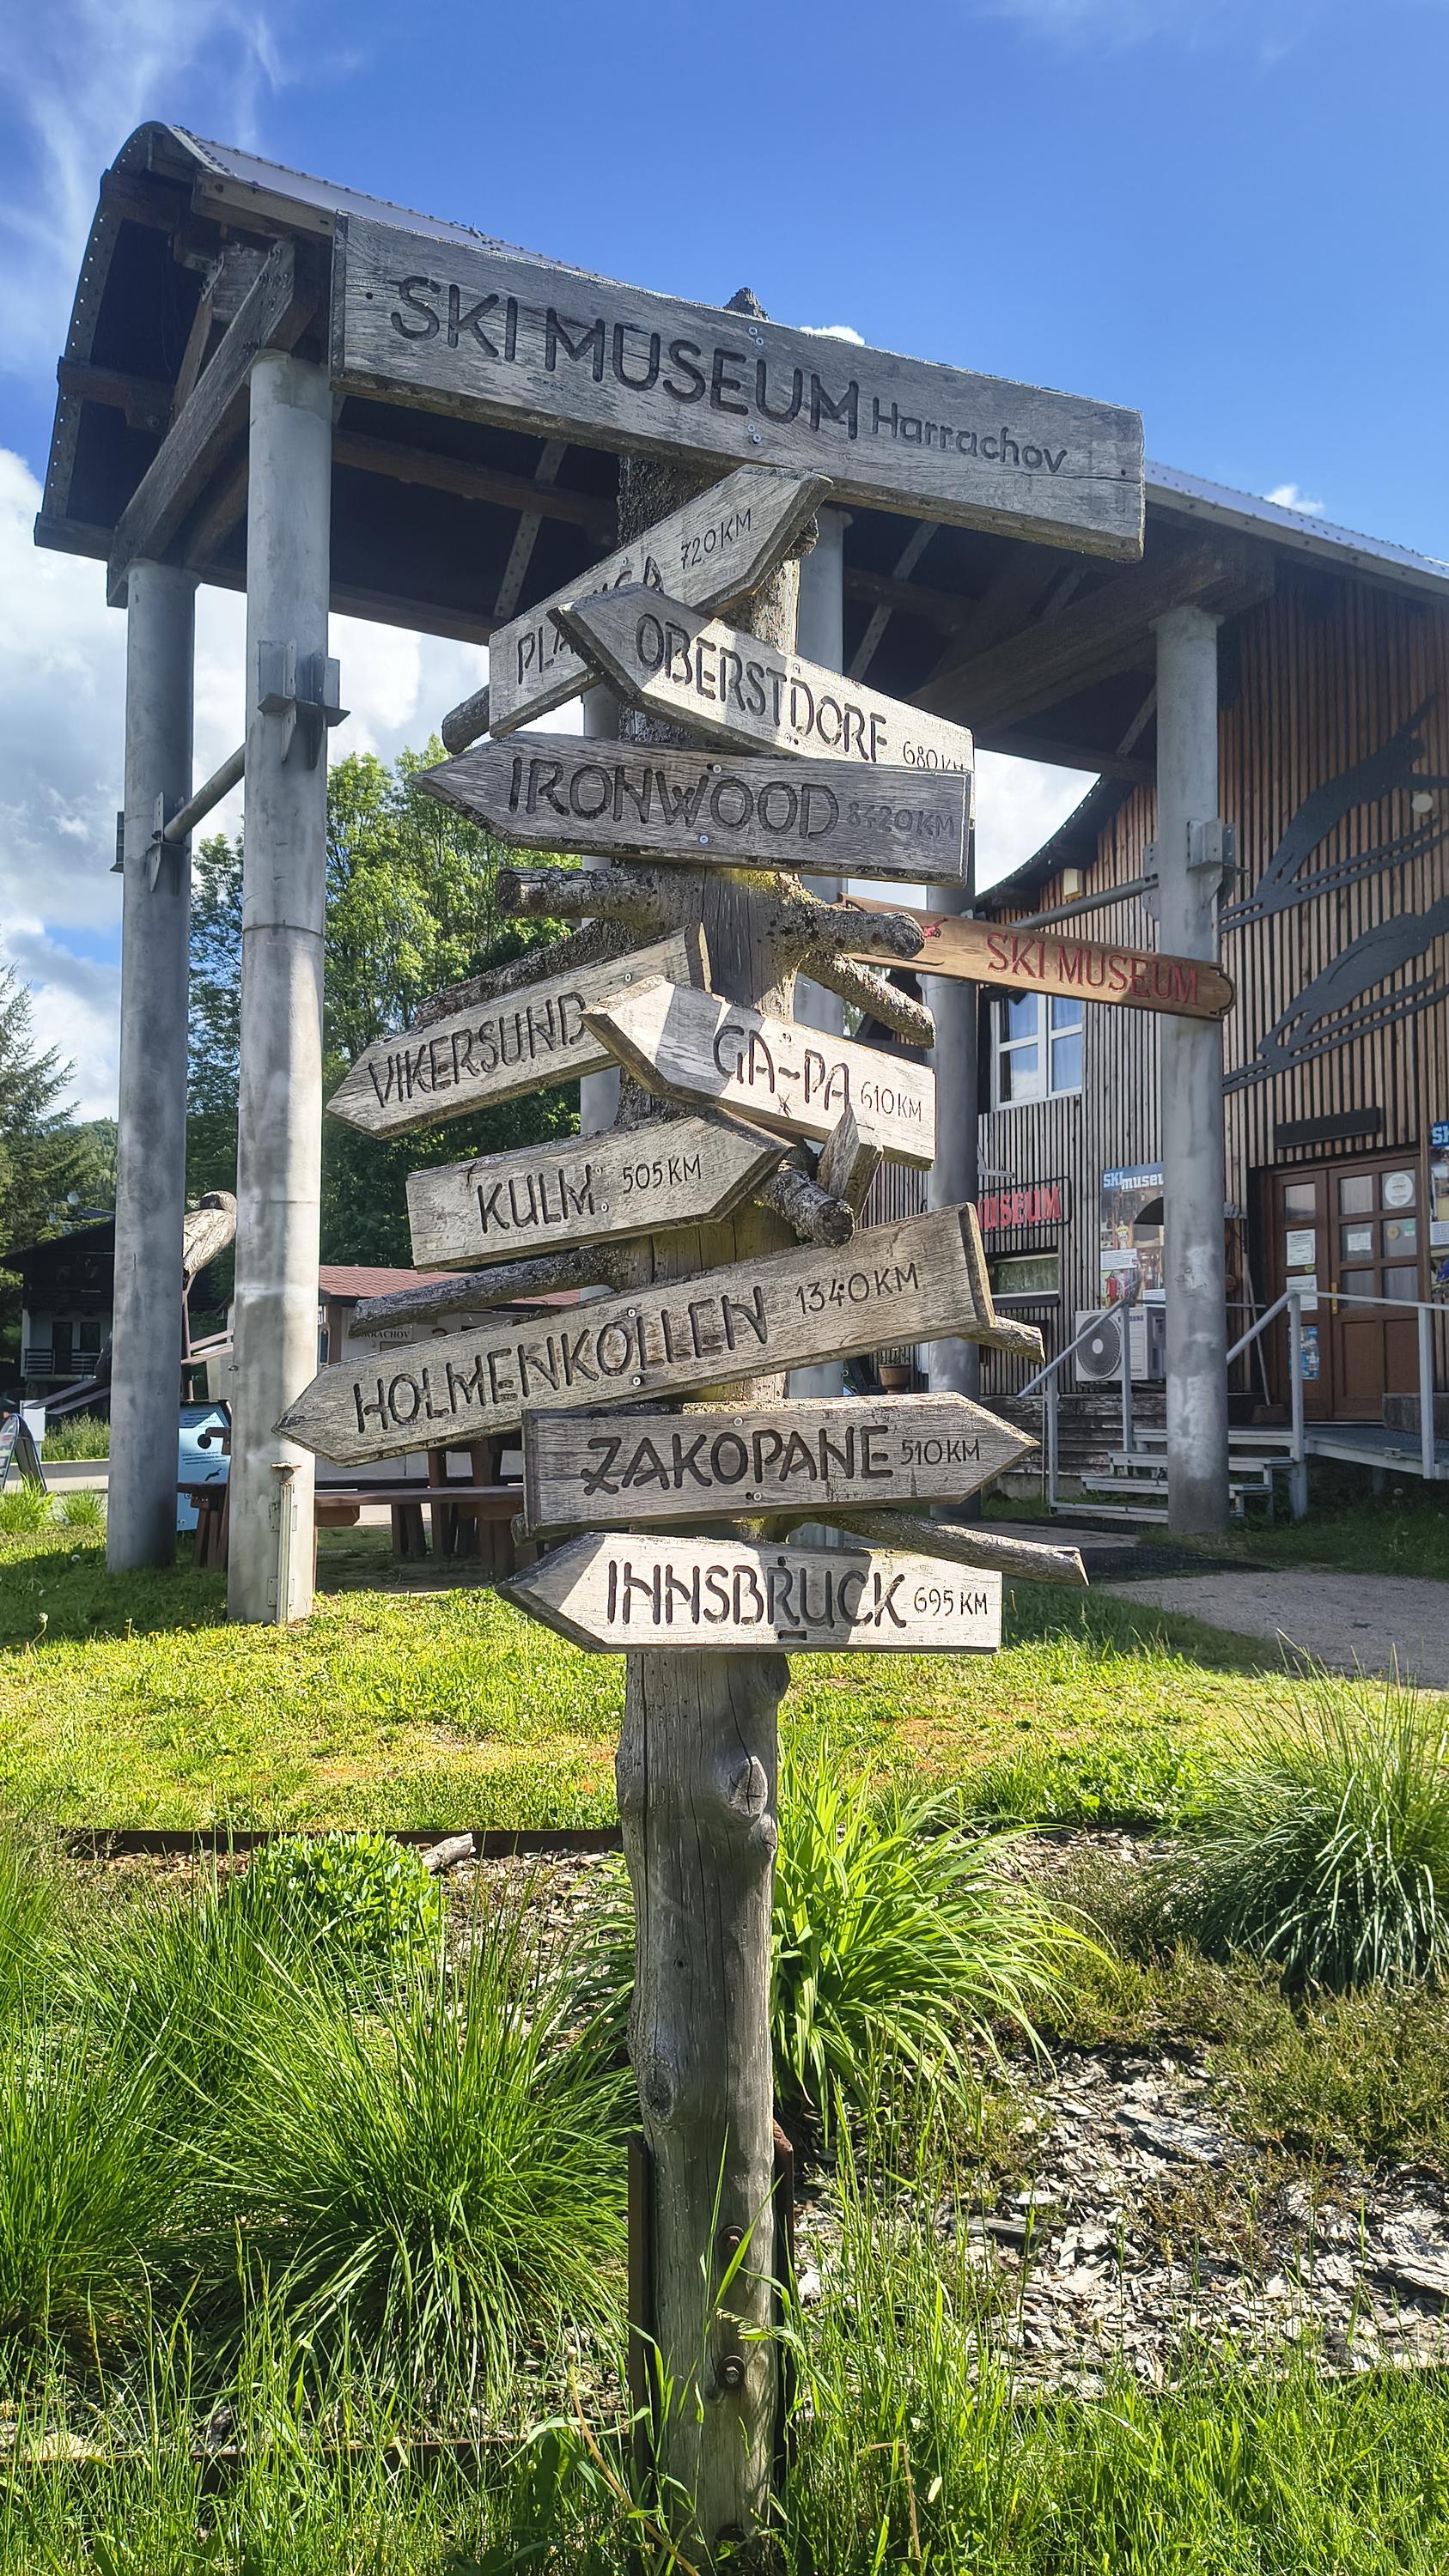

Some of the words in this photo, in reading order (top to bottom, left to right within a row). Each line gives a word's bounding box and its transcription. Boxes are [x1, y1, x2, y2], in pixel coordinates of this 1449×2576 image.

[391, 275, 517, 361] SKI
[545, 307, 859, 440] MUSEUM
[873, 397, 1067, 472] Harrachov
[636, 613, 886, 762] OBERSTDORF
[509, 756, 839, 838] IRONWOOD
[987, 932, 1045, 980] SKI
[1058, 945, 1197, 1005] MUSEUM
[368, 991, 587, 1108] VIKERSUND
[713, 1025, 849, 1111] GA-PA
[477, 1164, 595, 1233] KULM
[977, 1186, 1060, 1230] USEUM
[1104, 1171, 1123, 1188] SKI
[353, 1286, 768, 1433] HOLMENKOLLEN
[581, 1425, 893, 1496] ZAKOPANE
[608, 1559, 907, 1628] INNSBRUCK
